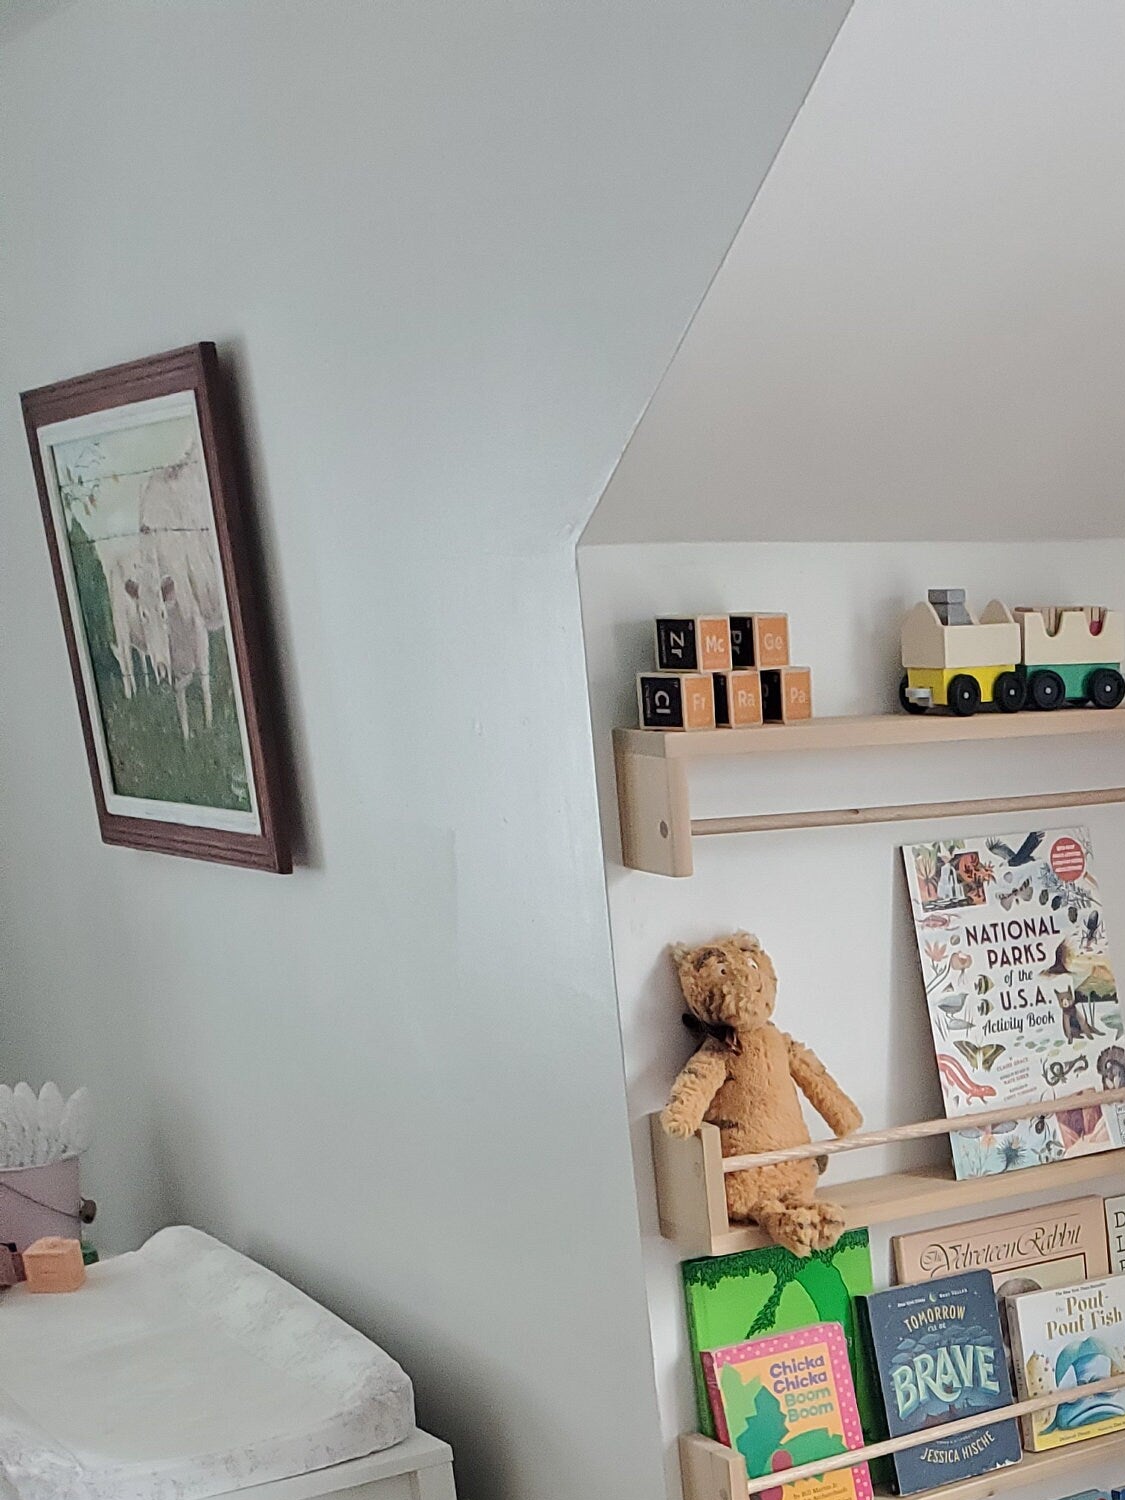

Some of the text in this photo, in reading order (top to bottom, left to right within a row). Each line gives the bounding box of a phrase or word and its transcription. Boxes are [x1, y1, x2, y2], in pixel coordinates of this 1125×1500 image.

[669, 630, 685, 659] Zr
[705, 634, 725, 654] Mc
[654, 690, 672, 715] Cl
[965, 915, 1061, 947] NATIONAL
[986, 942, 1047, 970] PARKS
[1004, 969, 1034, 987] of the
[1000, 985, 1053, 1011] U.S.A.
[982, 1010, 1056, 1037] Activity Book
[928, 1242, 1017, 1276] Velveteen
[1018, 1222, 1081, 1257] Rabbit
[903, 1304, 966, 1333] TOMORROW
[1046, 1306, 1123, 1341] Pout Fish
[769, 1355, 825, 1378] Chicka
[773, 1371, 828, 1394] Chicka
[892, 1344, 1000, 1420] BRAVE
[784, 1387, 831, 1407] Boom
[787, 1402, 834, 1423] Boom
[920, 1447, 961, 1464] JESSICA
[961, 1430, 996, 1460] HISCHE
